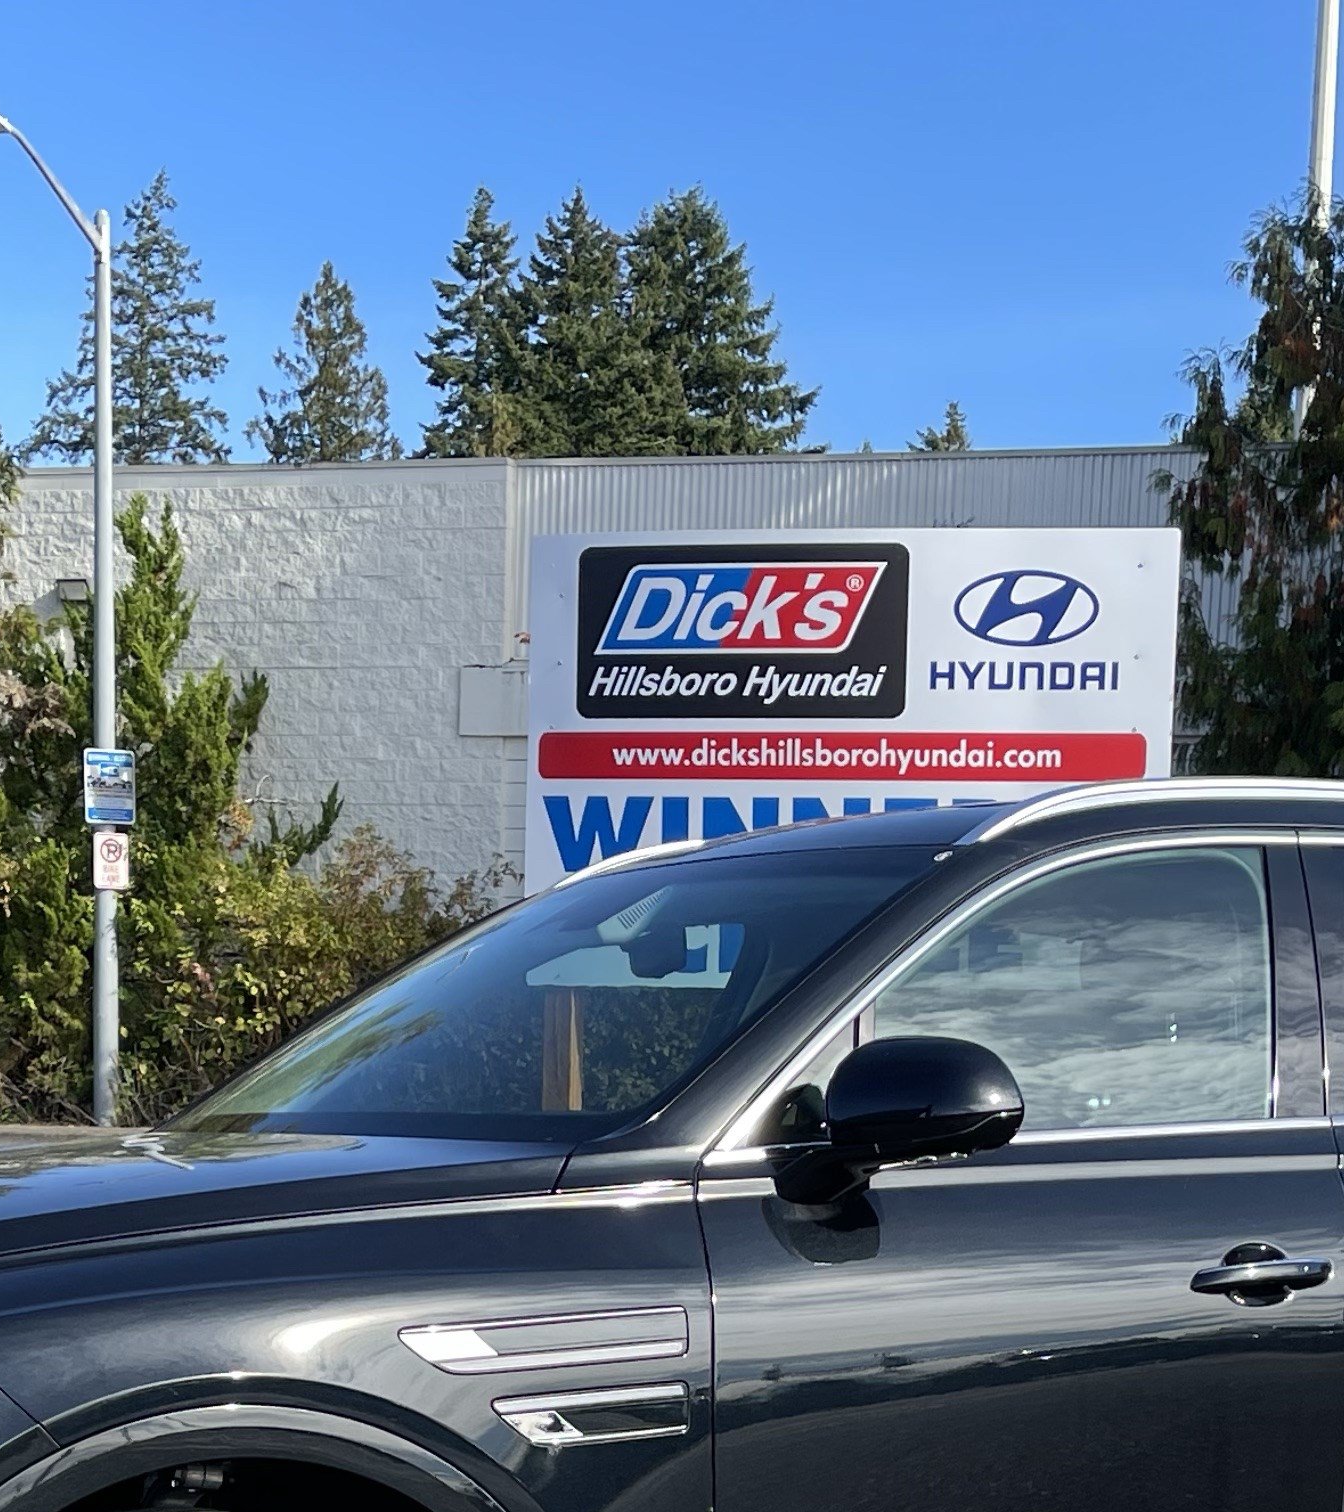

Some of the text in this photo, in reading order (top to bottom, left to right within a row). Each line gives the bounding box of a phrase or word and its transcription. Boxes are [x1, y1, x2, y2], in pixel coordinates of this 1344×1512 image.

[616, 572, 849, 643] Dick's
[588, 665, 889, 705] Hillsboro Hyundai
[929, 661, 1119, 691] HYUNDAI
[611, 742, 1062, 775] www.dickshillsborohyundai.com
